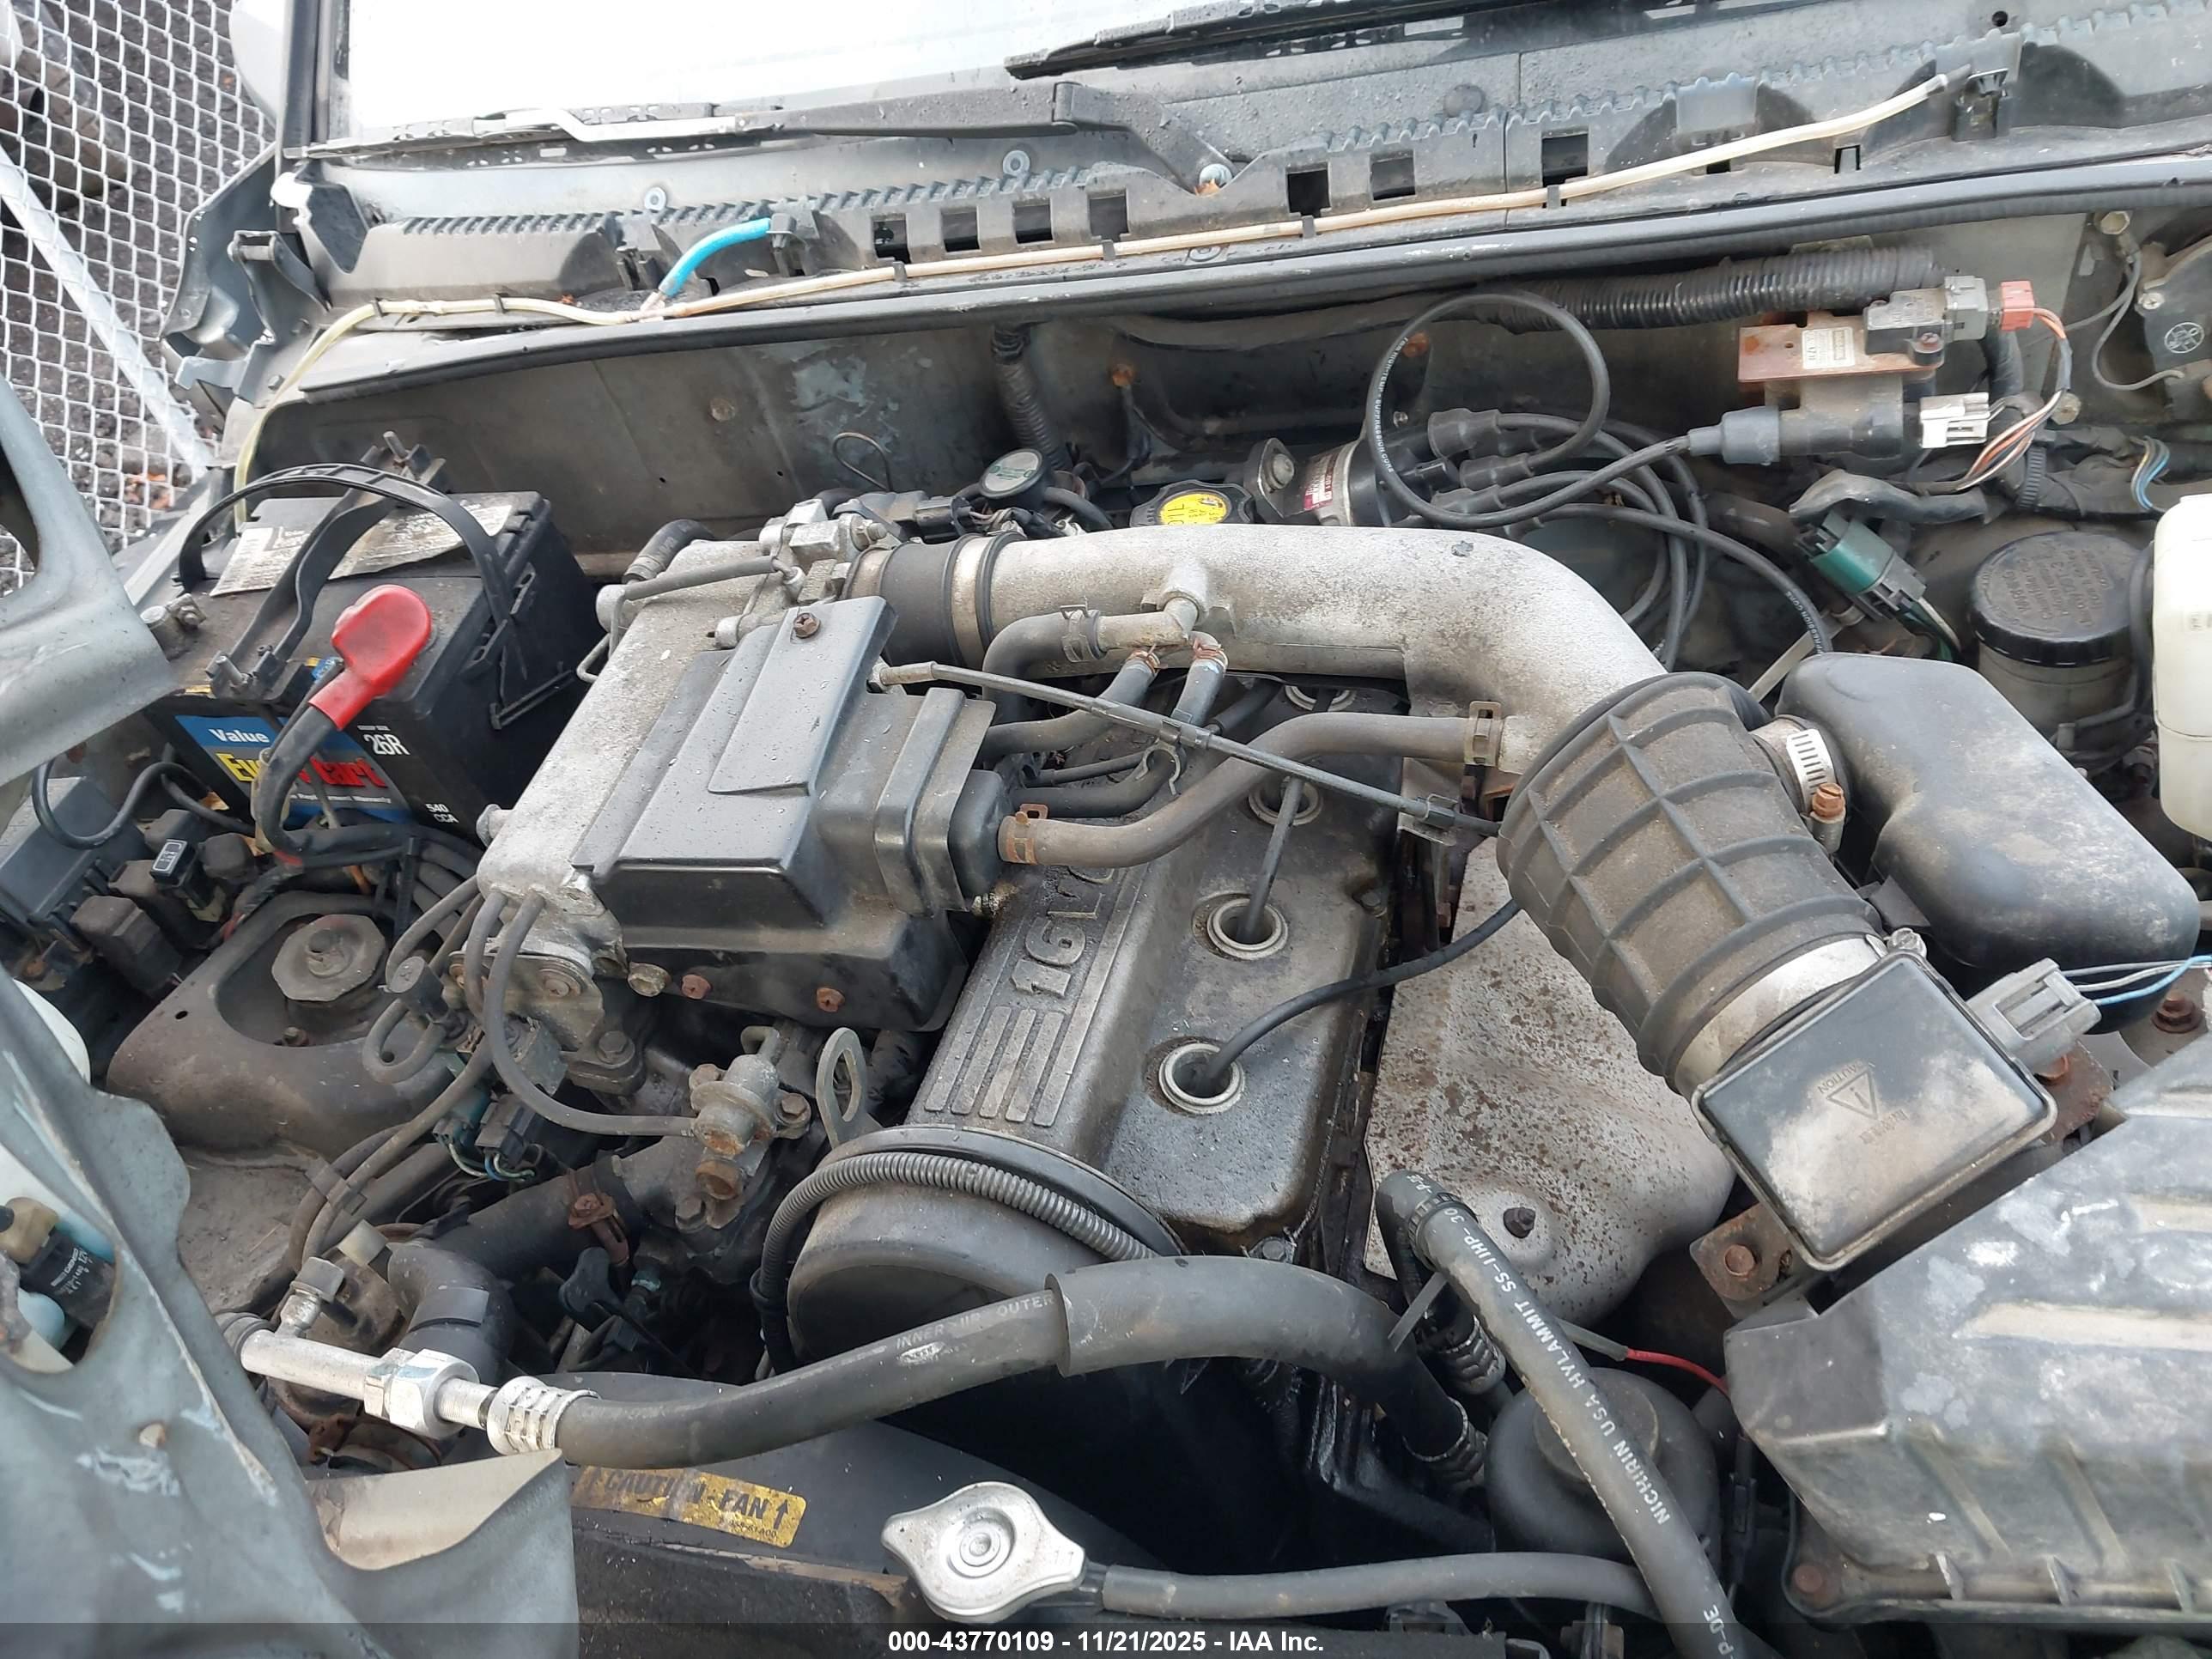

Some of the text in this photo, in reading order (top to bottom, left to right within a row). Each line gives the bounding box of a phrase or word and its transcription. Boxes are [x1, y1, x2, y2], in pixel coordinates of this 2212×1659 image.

[210, 728, 270, 744] Value
[363, 733, 411, 756] 26R
[425, 804, 450, 813] 540
[433, 813, 460, 823] CCA
[1817, 1061, 1863, 1095] AUTION
[896, 1323, 945, 1349] INNER
[996, 1294, 1055, 1317] OUTER
[1514, 1299, 1586, 1389] HYLAMMIT
[1585, 1393, 1616, 1437] USA
[604, 1472, 708, 1503] CAUTIN
[719, 1489, 769, 1520] FAN
[1613, 1439, 1671, 1525] NICHIRIN
